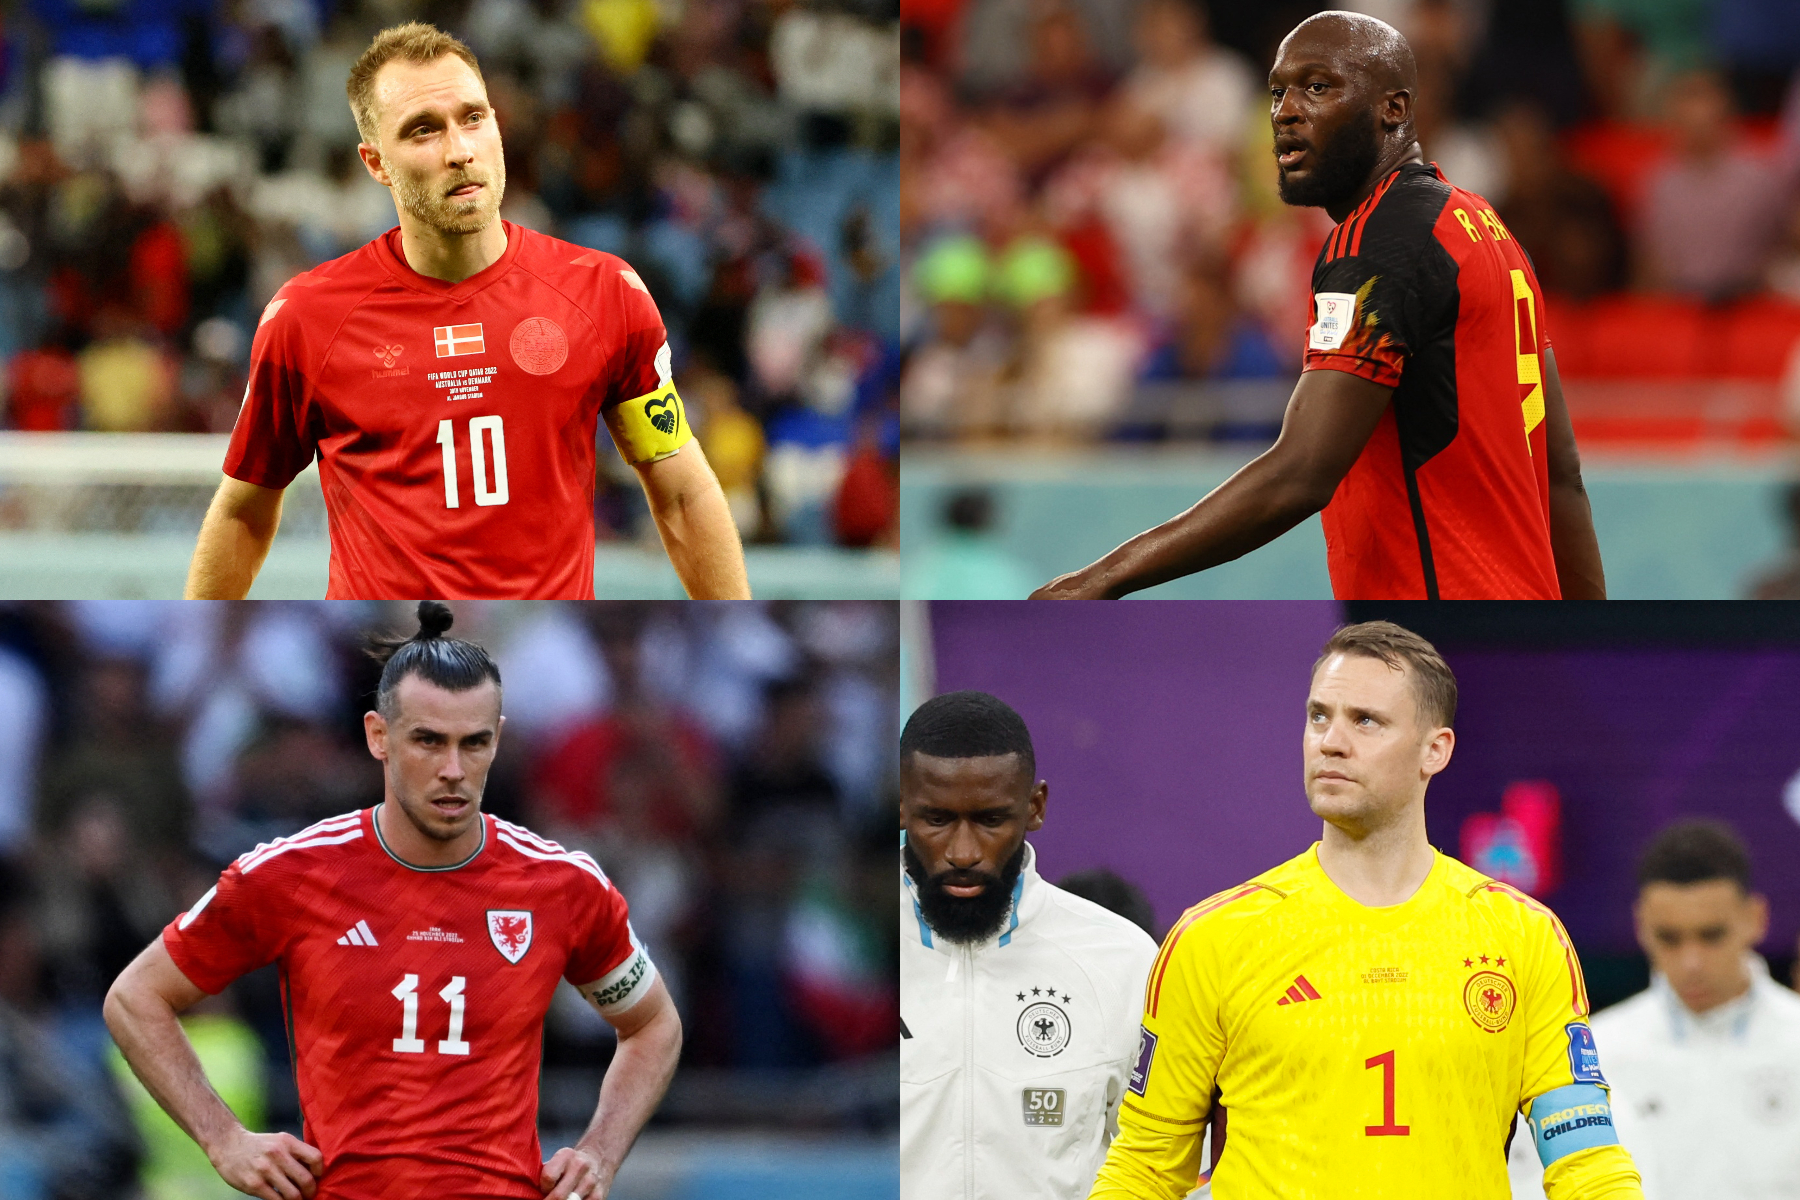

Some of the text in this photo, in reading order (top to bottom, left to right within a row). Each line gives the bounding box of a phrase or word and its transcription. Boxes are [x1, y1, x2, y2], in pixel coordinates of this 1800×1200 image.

[372, 366, 410, 379] hummel
[439, 371, 457, 379] WORLD
[469, 368, 484, 377] QATAR
[484, 367, 497, 375] 2022
[1510, 269, 1546, 457] 9
[435, 379, 462, 388] AUSTRALIA
[468, 376, 492, 385] DENMARK
[436, 415, 509, 508] 10
[592, 976, 630, 998] SAVE
[1476, 978, 1508, 993] DEUTSCHER
[391, 974, 470, 1055] 11
[1028, 1009, 1060, 1020] DEUTSCHER
[1029, 1091, 1058, 1111] 50
[1365, 1050, 1410, 1136] 1
[1540, 1104, 1609, 1130] PROTECT
[1543, 1116, 1612, 1140] CHILDREN
